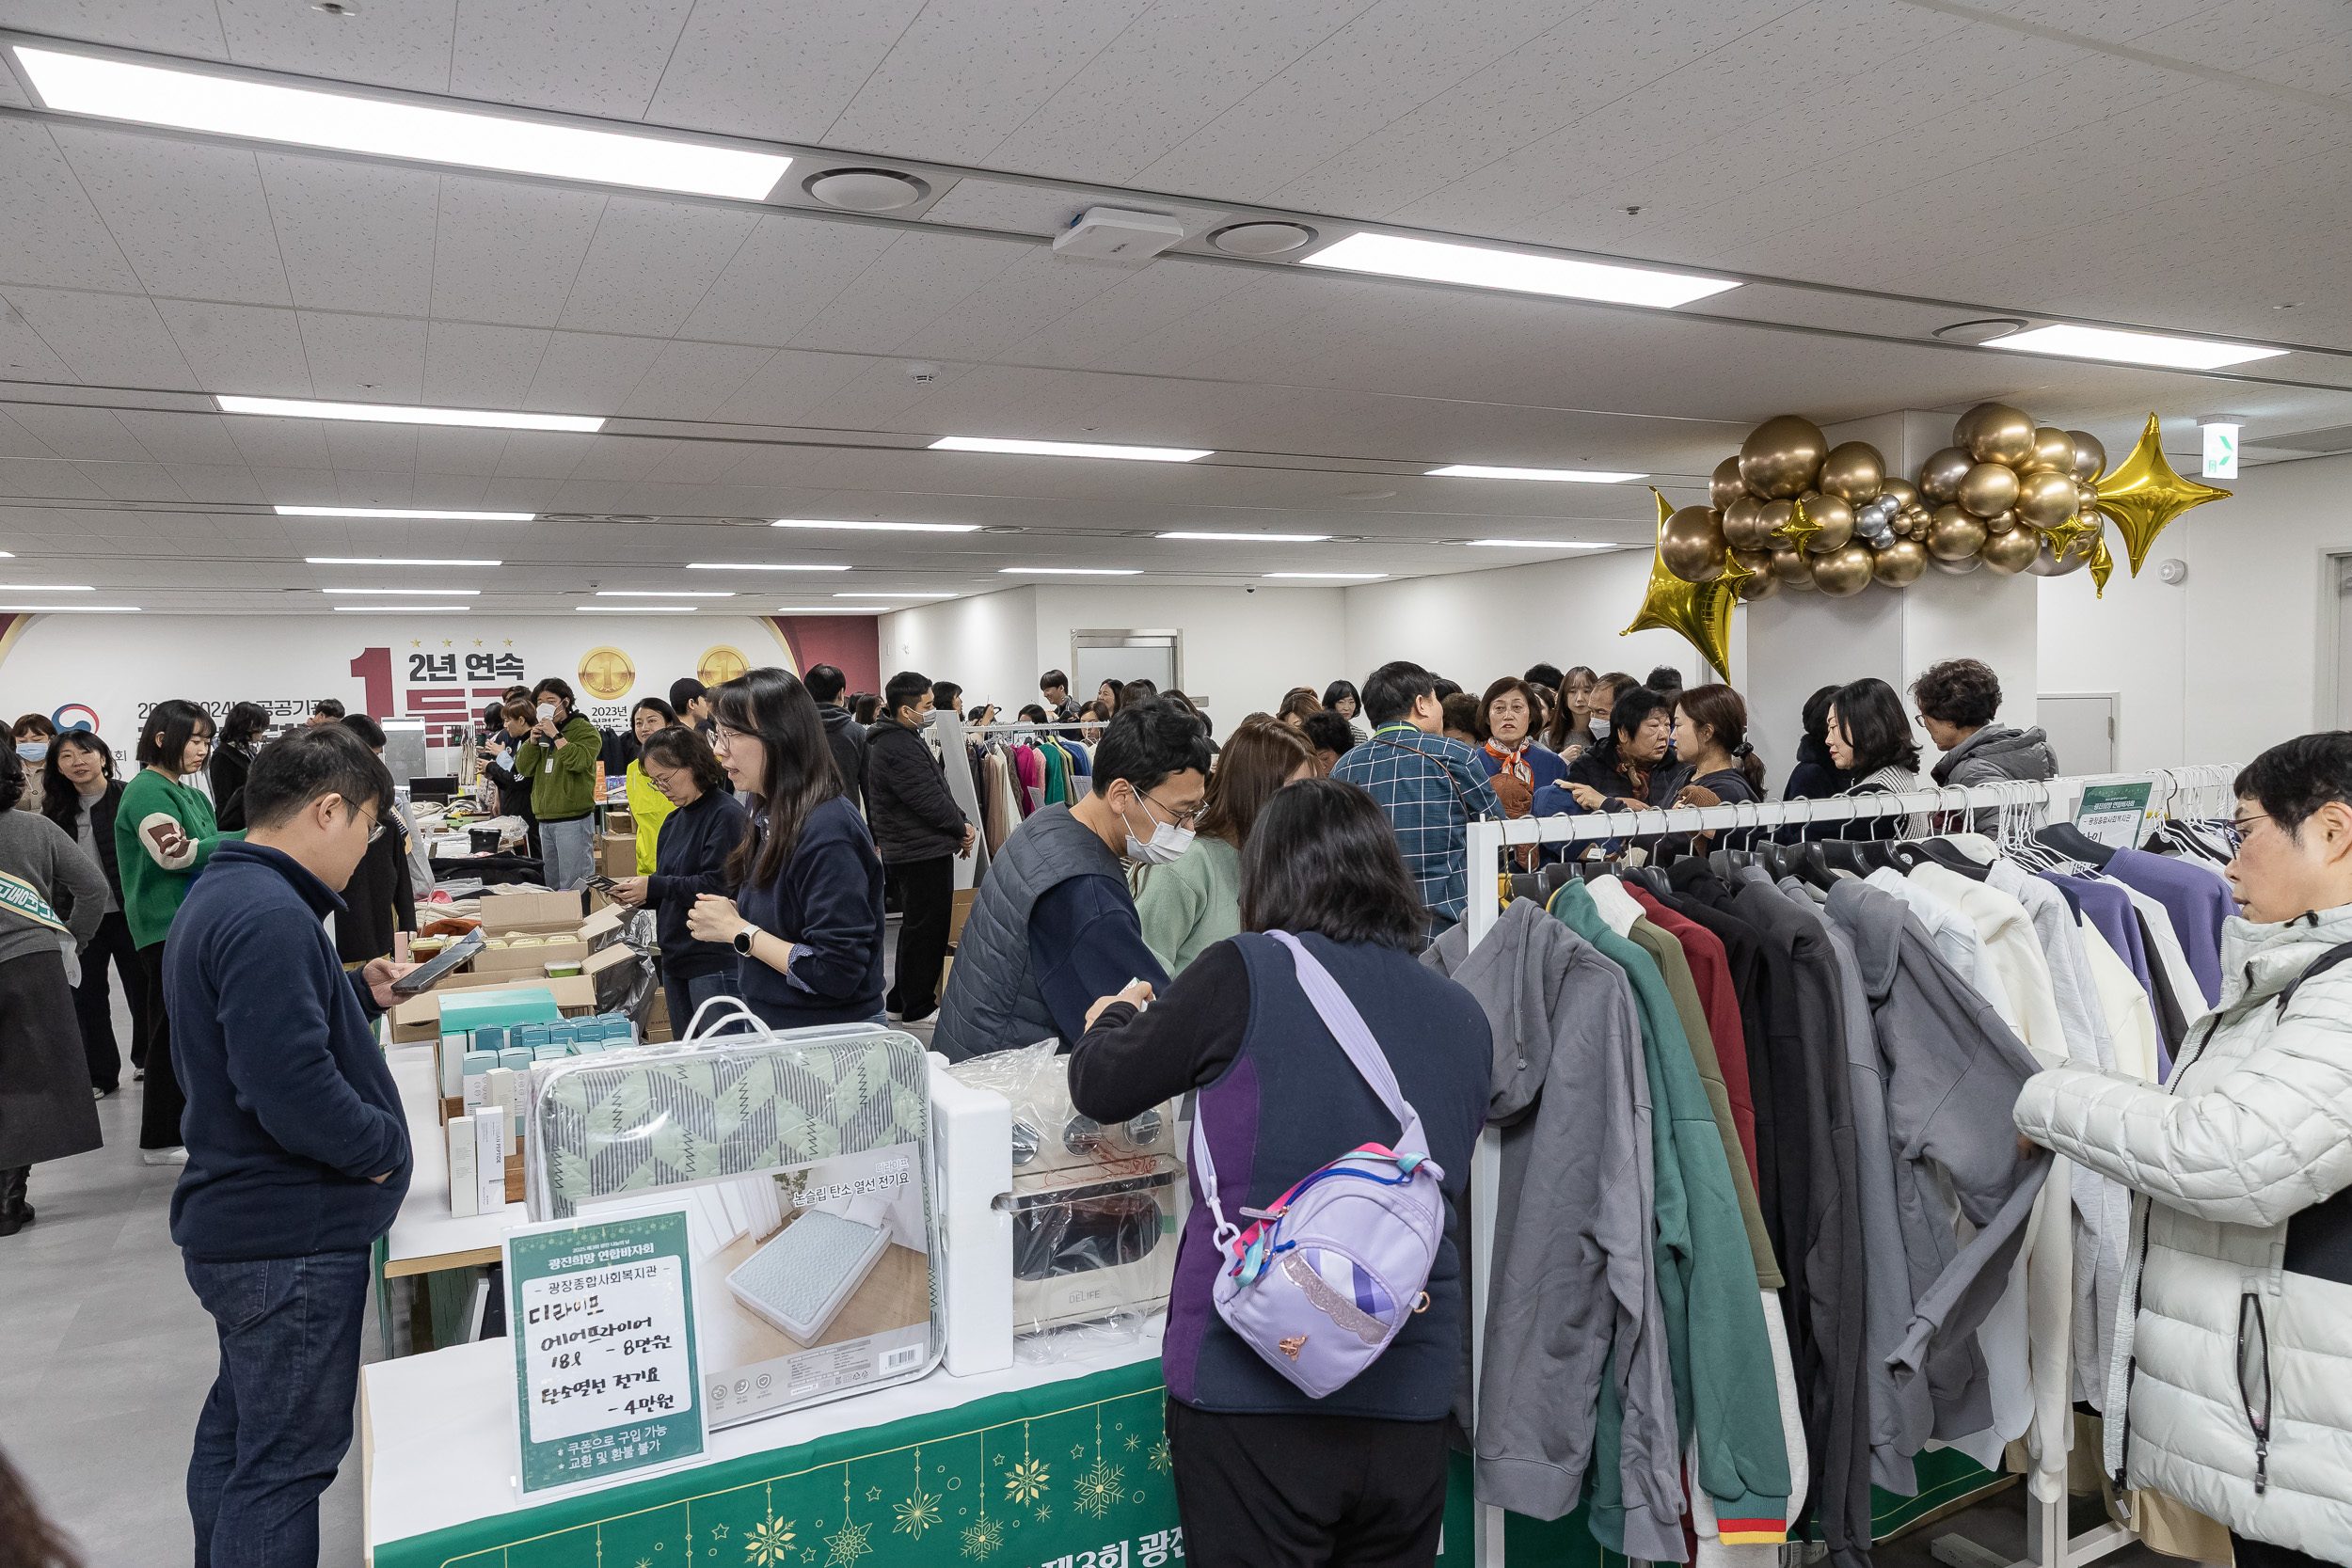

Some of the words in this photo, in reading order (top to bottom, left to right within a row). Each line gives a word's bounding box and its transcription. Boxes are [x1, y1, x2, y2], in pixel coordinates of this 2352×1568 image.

[409, 654, 457, 682] 2년
[465, 653, 525, 681] 연속
[592, 705, 628, 717] 2023년
[875, 1158, 910, 1175] 디라이프
[793, 1187, 827, 1207] 논슬립
[830, 1182, 852, 1199] 탄소
[854, 1178, 876, 1196] 열선
[878, 1171, 911, 1190] 전기요
[548, 1253, 596, 1270] 광진희망
[597, 1242, 655, 1262] 연합바자회
[548, 1264, 658, 1295] 광장종합사회복지관
[529, 1294, 604, 1325] 디라이프
[1069, 1290, 1100, 1304] DELIFE
[541, 1317, 652, 1352] 에어프라이어
[624, 1334, 673, 1356] 8만원
[541, 1378, 607, 1405] 탄소열선
[613, 1367, 660, 1388] 전기요
[624, 1393, 675, 1415] 4만원
[568, 1435, 615, 1455] 쿠폰으로
[618, 1428, 642, 1445] 구입
[644, 1423, 668, 1439] 가능
[568, 1454, 593, 1470] 교환
[596, 1451, 609, 1465] 및
[612, 1445, 635, 1461] 환불
[638, 1439, 661, 1456] 불가
